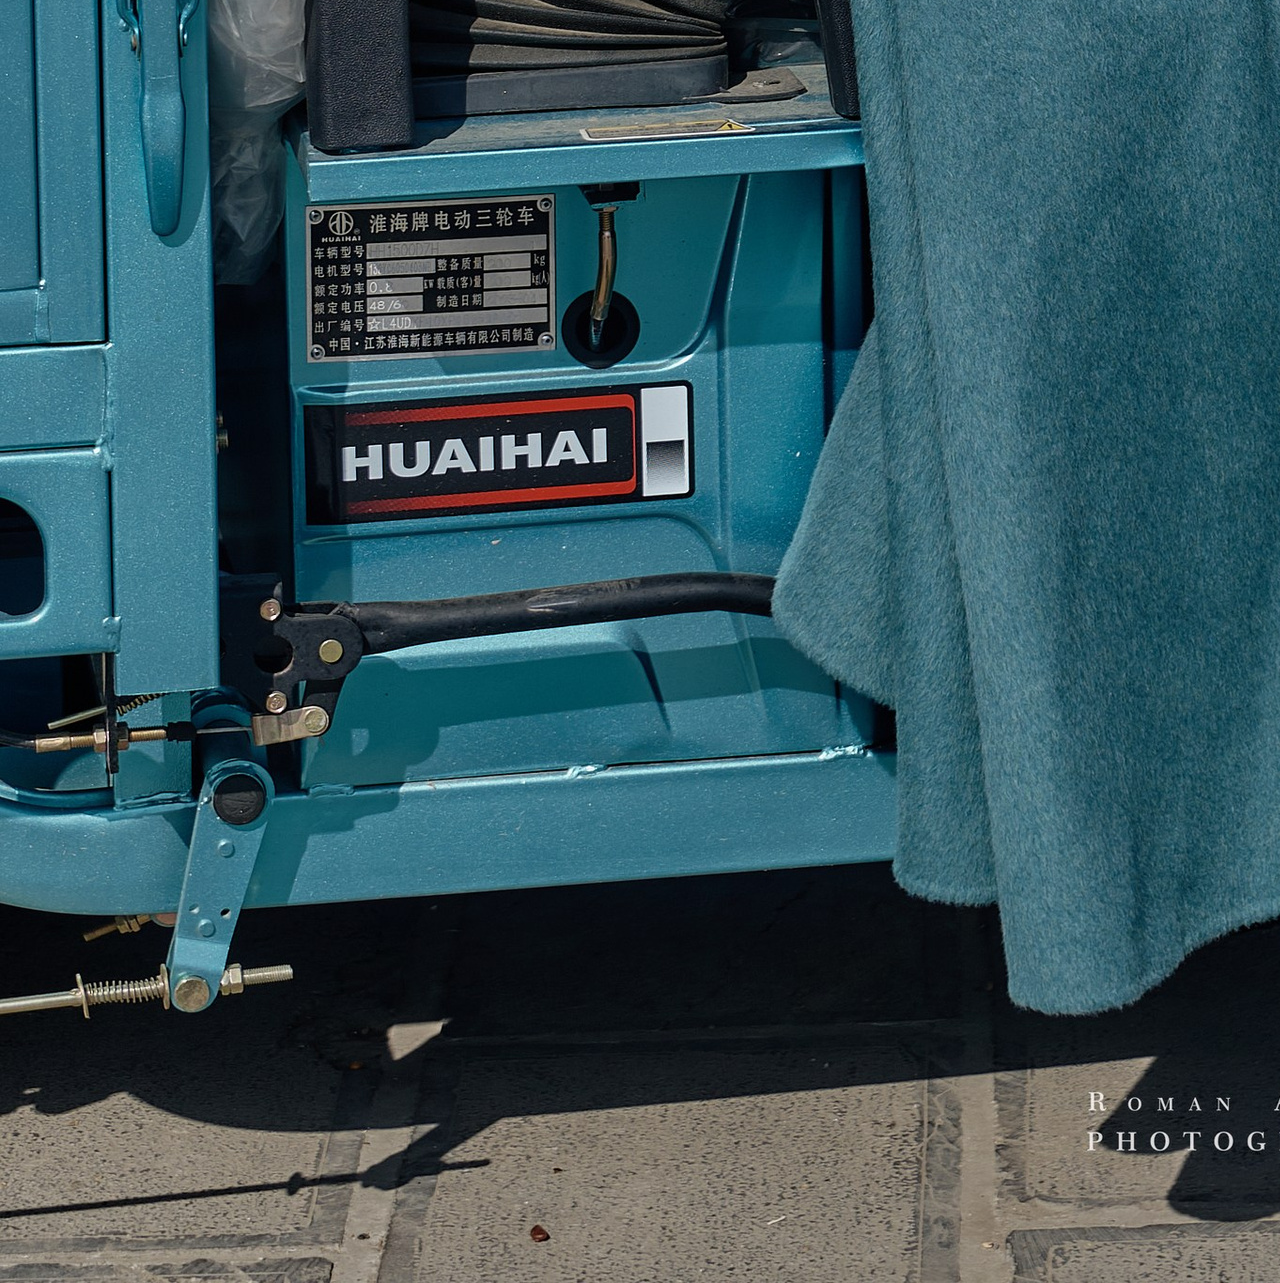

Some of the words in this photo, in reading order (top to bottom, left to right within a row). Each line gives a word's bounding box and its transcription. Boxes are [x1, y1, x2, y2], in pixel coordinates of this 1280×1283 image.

[369, 206, 534, 233] 淮海牌电动三轮车
[321, 235, 361, 243] HUAIHAI
[313, 246, 365, 260] 车辆型号
[436, 256, 483, 272] 整备质量
[533, 253, 546, 267] kg
[313, 264, 365, 278] 电机型号
[313, 282, 365, 298] 额定功率
[313, 300, 365, 316] 额定电压
[436, 293, 482, 308] 制造日期
[313, 318, 365, 334] 出厂编号
[329, 328, 534, 351] 中国·江苏淮海新能源车辆有限公司制造
[342, 428, 608, 482] HUAIHAI
